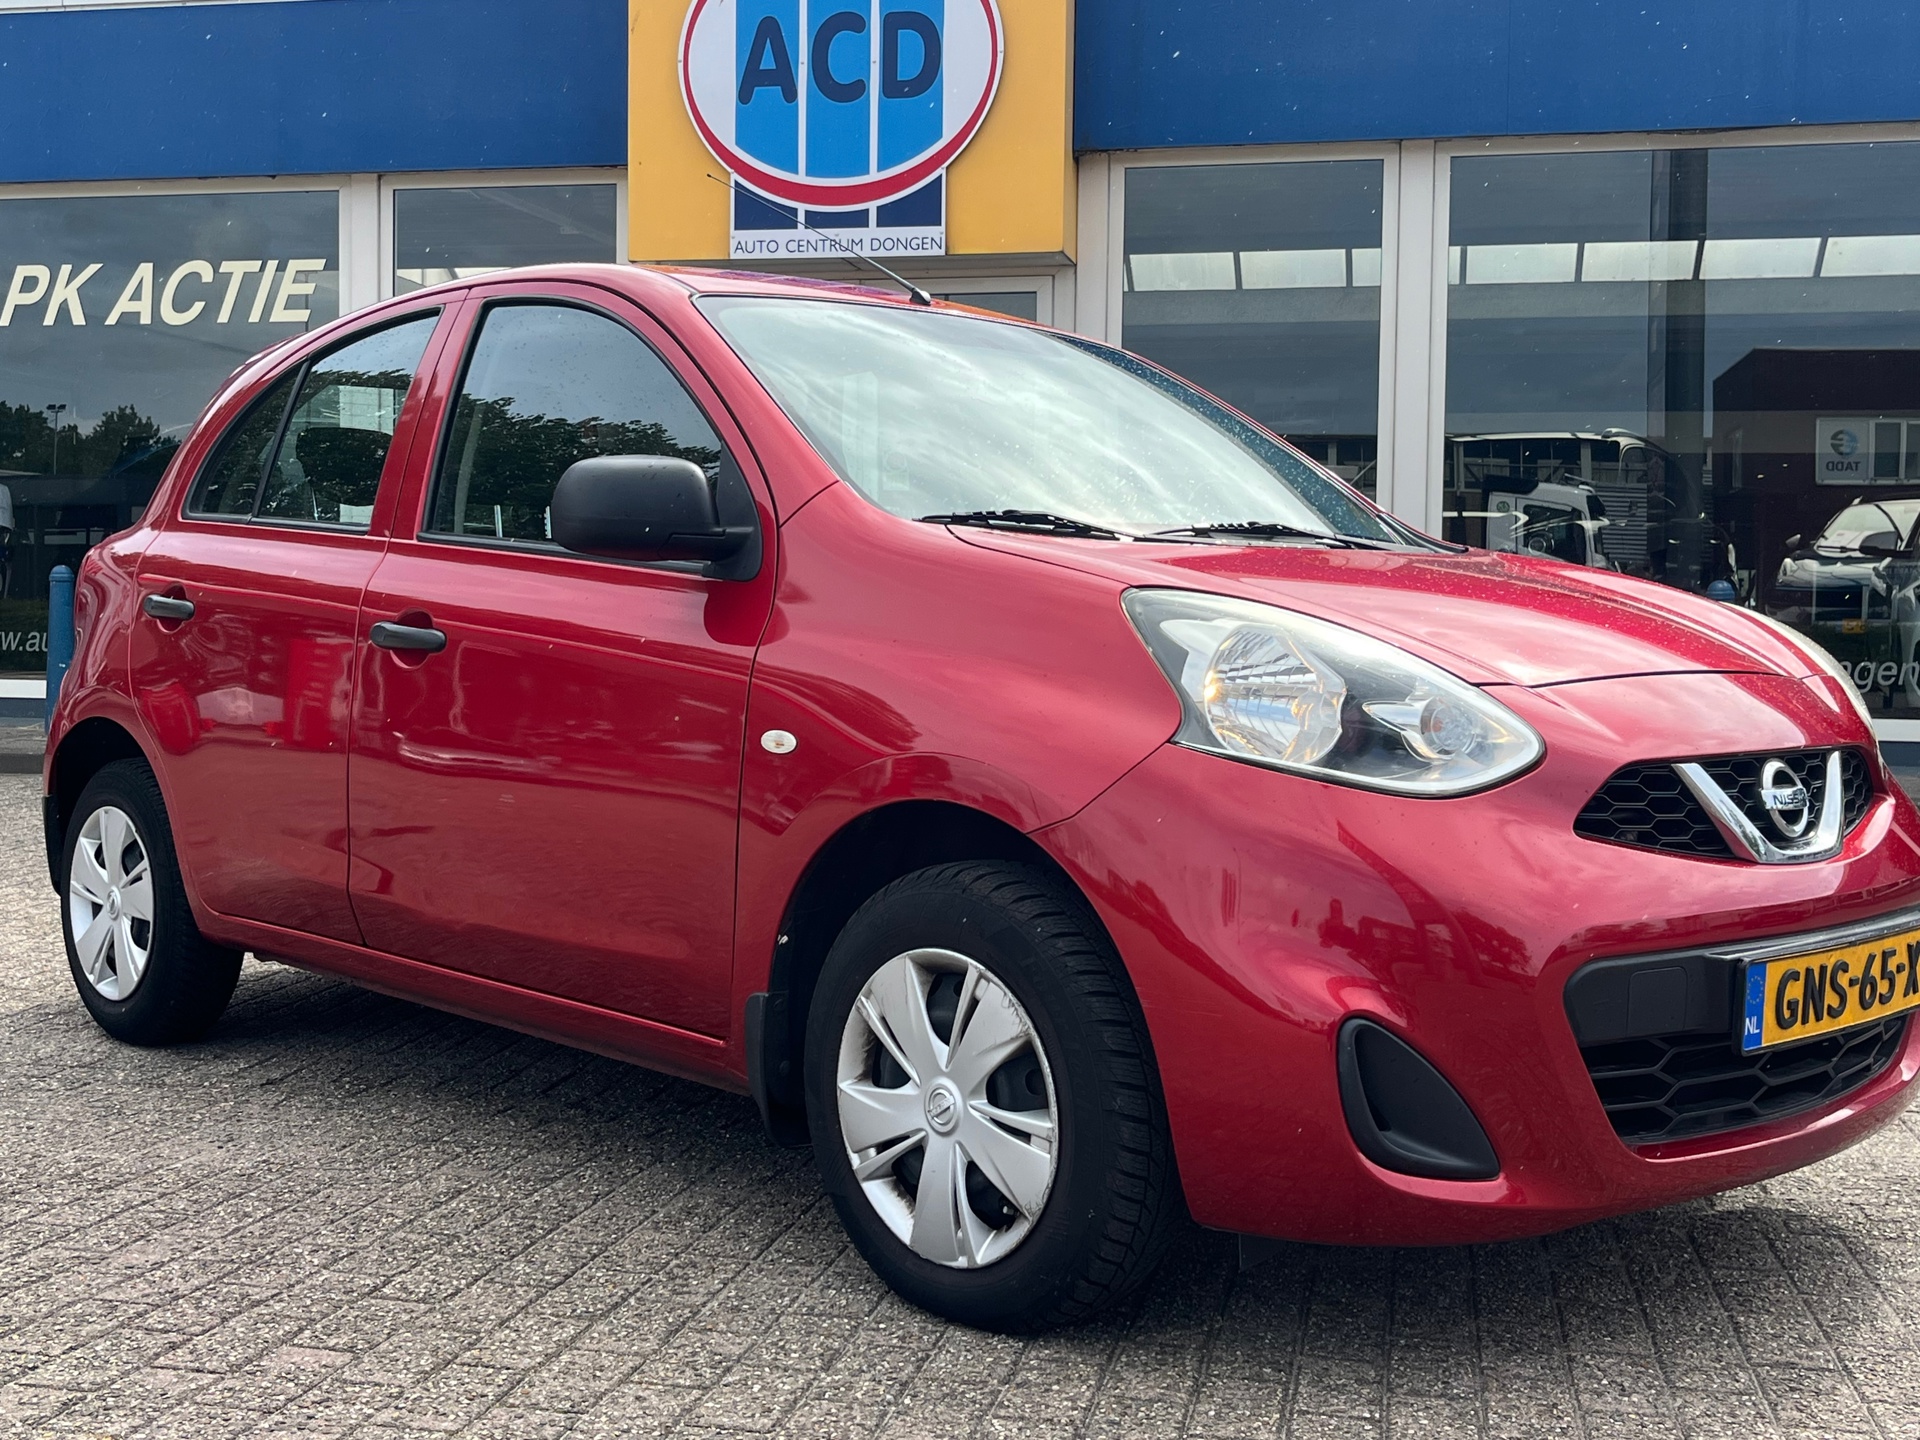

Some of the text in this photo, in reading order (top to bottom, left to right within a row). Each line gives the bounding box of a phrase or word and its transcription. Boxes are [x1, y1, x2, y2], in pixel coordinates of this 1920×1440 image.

[738, 11, 941, 105] ACD
[734, 236, 943, 254] AUTO CENTRUM DONGEN
[0, 259, 327, 326] PK ACTIE
[1772, 791, 1806, 806] NISS
[1775, 941, 1920, 1030] GNS-65-X
[1744, 1016, 1760, 1036] NL
